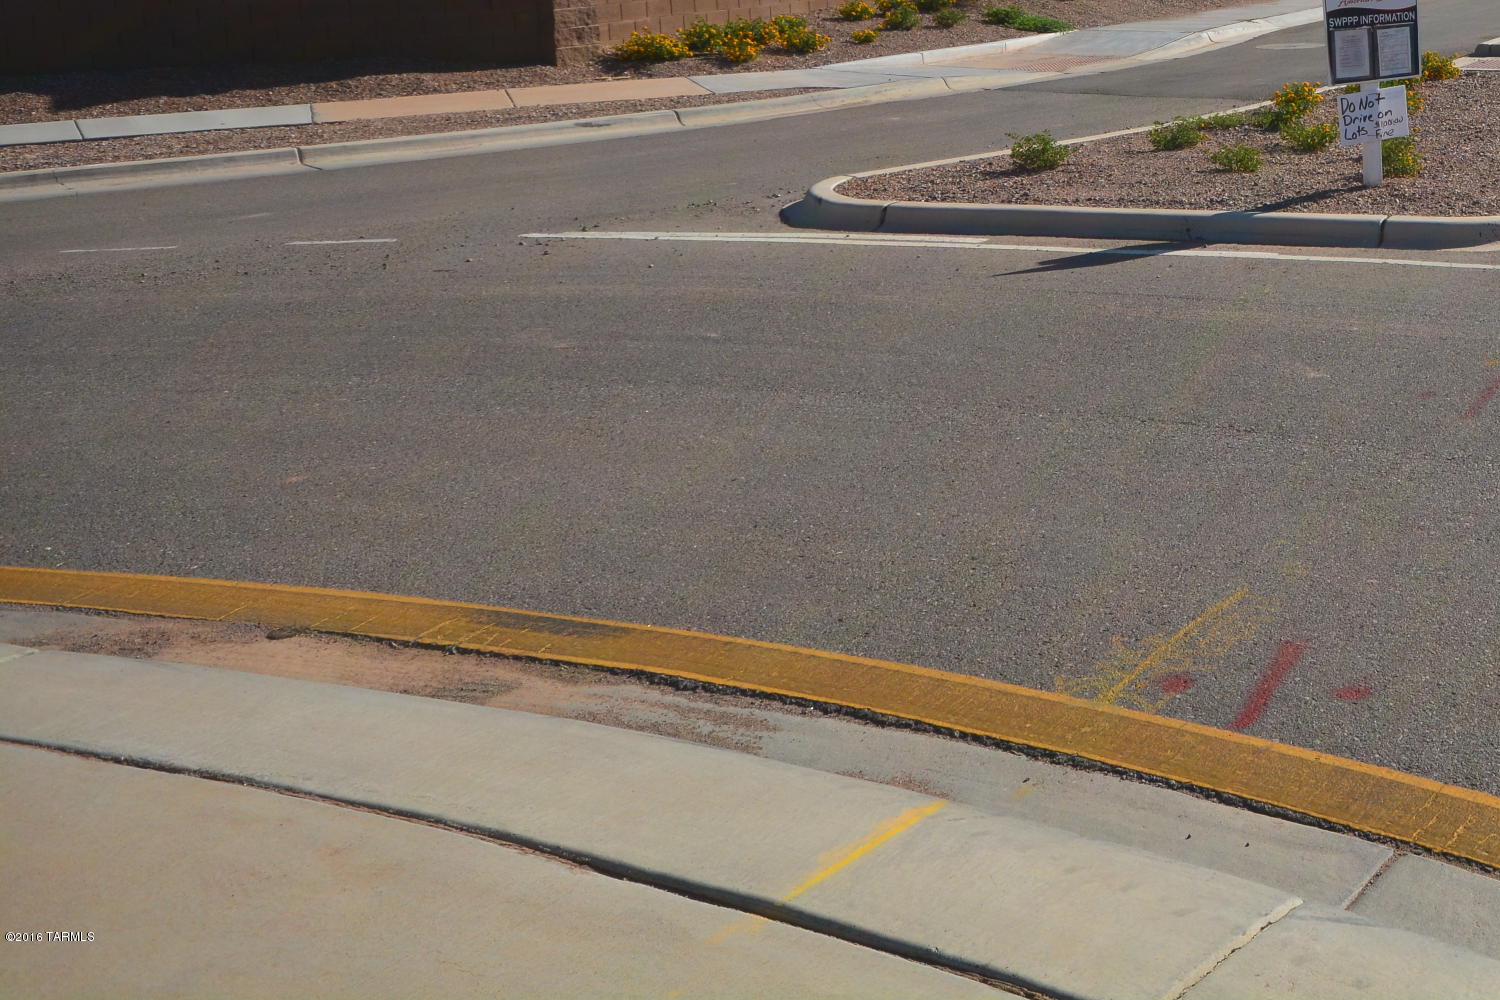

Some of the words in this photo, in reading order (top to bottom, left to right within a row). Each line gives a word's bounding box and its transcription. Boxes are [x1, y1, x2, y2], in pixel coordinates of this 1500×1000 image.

[1329, 15, 1359, 27] SWPPP
[1360, 11, 1415, 25] INFORMATION
[1340, 97, 1356, 115] Do
[1359, 93, 1385, 110] Not
[1342, 114, 1374, 126] Drive
[1377, 109, 1393, 119] on
[1344, 125, 1368, 140] Lots
[1375, 128, 1395, 139] Fine
